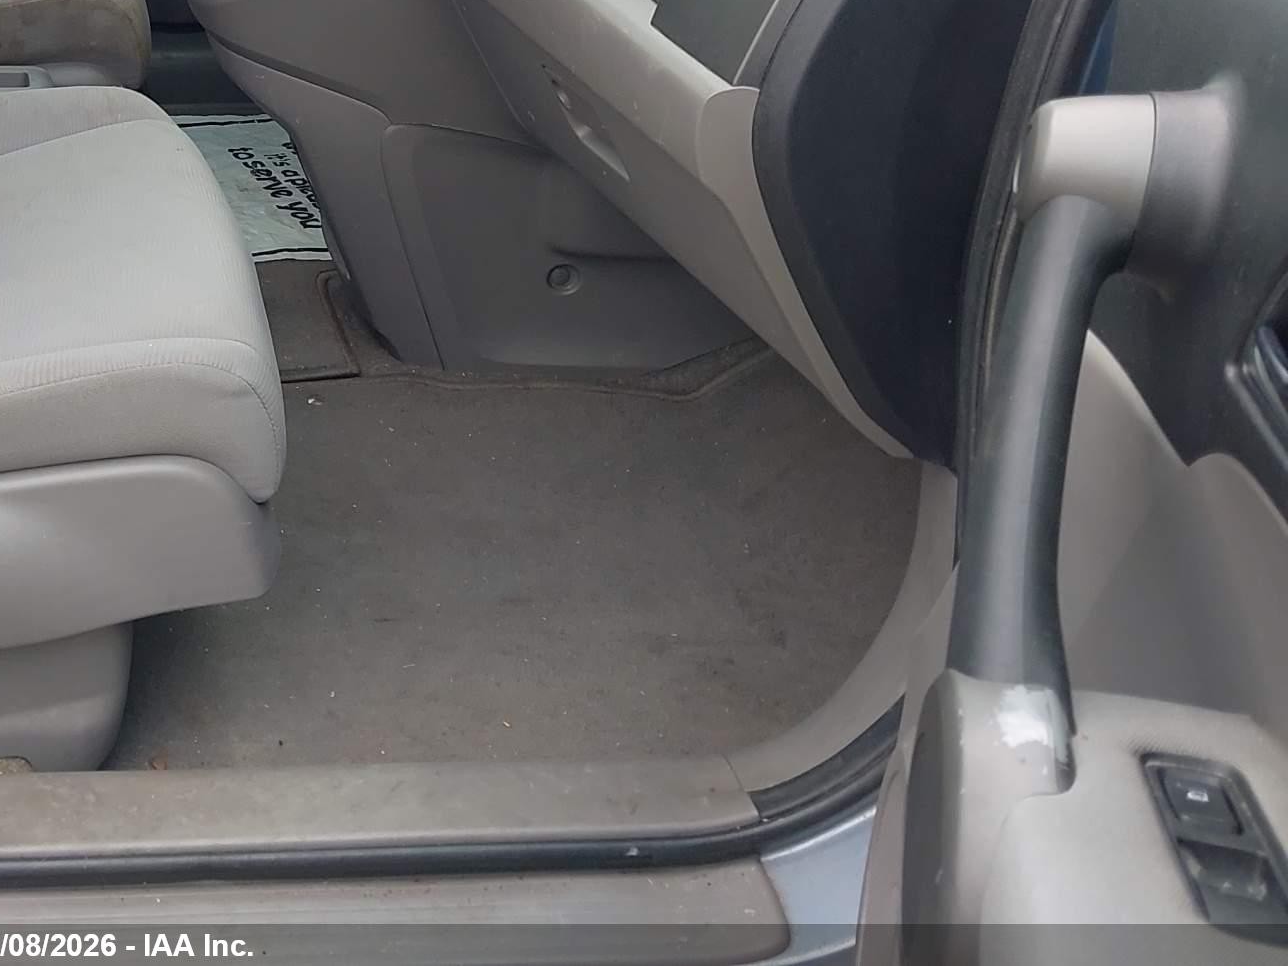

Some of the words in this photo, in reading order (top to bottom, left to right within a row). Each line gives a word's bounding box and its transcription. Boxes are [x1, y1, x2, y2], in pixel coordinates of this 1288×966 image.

[228, 146, 256, 161] to
[242, 160, 294, 199] serve
[275, 201, 323, 229] you
